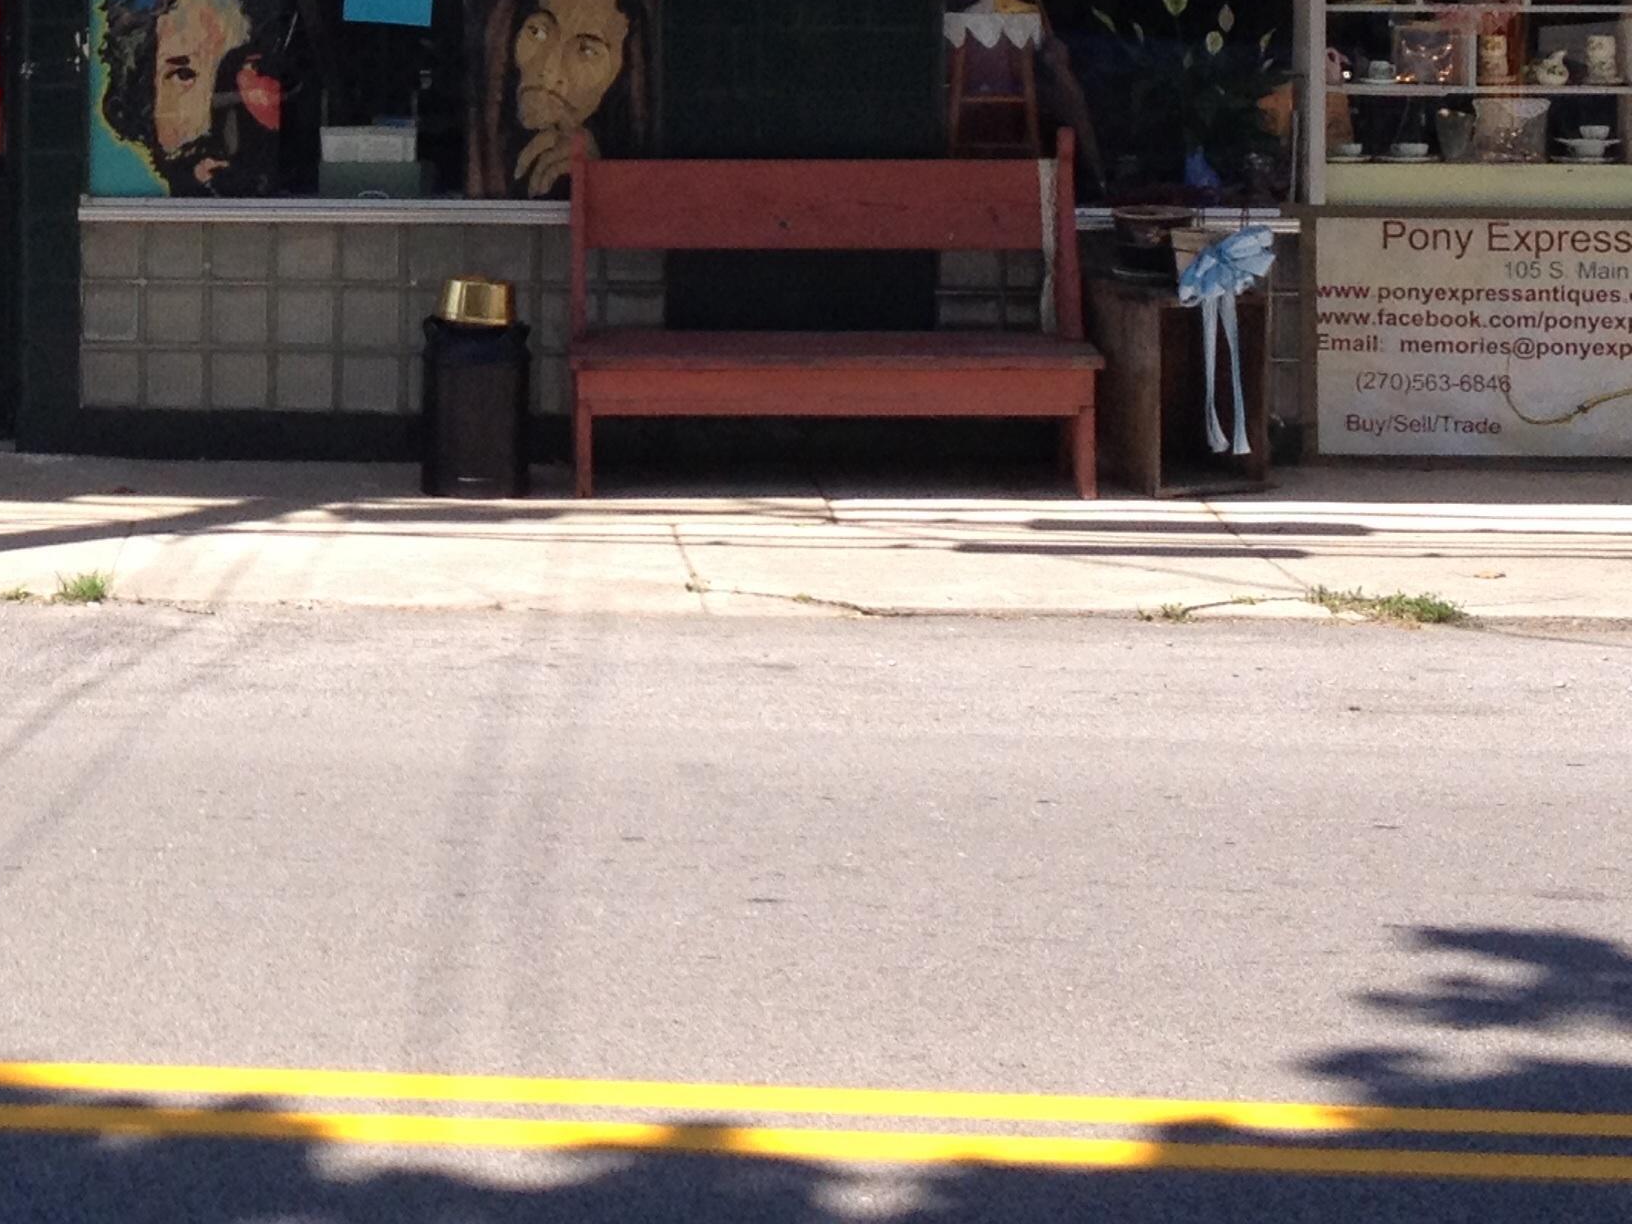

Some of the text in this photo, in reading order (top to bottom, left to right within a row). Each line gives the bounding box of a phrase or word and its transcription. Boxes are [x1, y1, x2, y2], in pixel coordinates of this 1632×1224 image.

[1382, 220, 1632, 260] Pony Express
[1505, 261, 1541, 279] 105
[1578, 261, 1629, 280] Main
[1317, 285, 1632, 306] www.ponyexpressantiques.
[1400, 337, 1632, 360] memories@ponyexp
[1345, 413, 1502, 436] Buy/Sell/Trade
